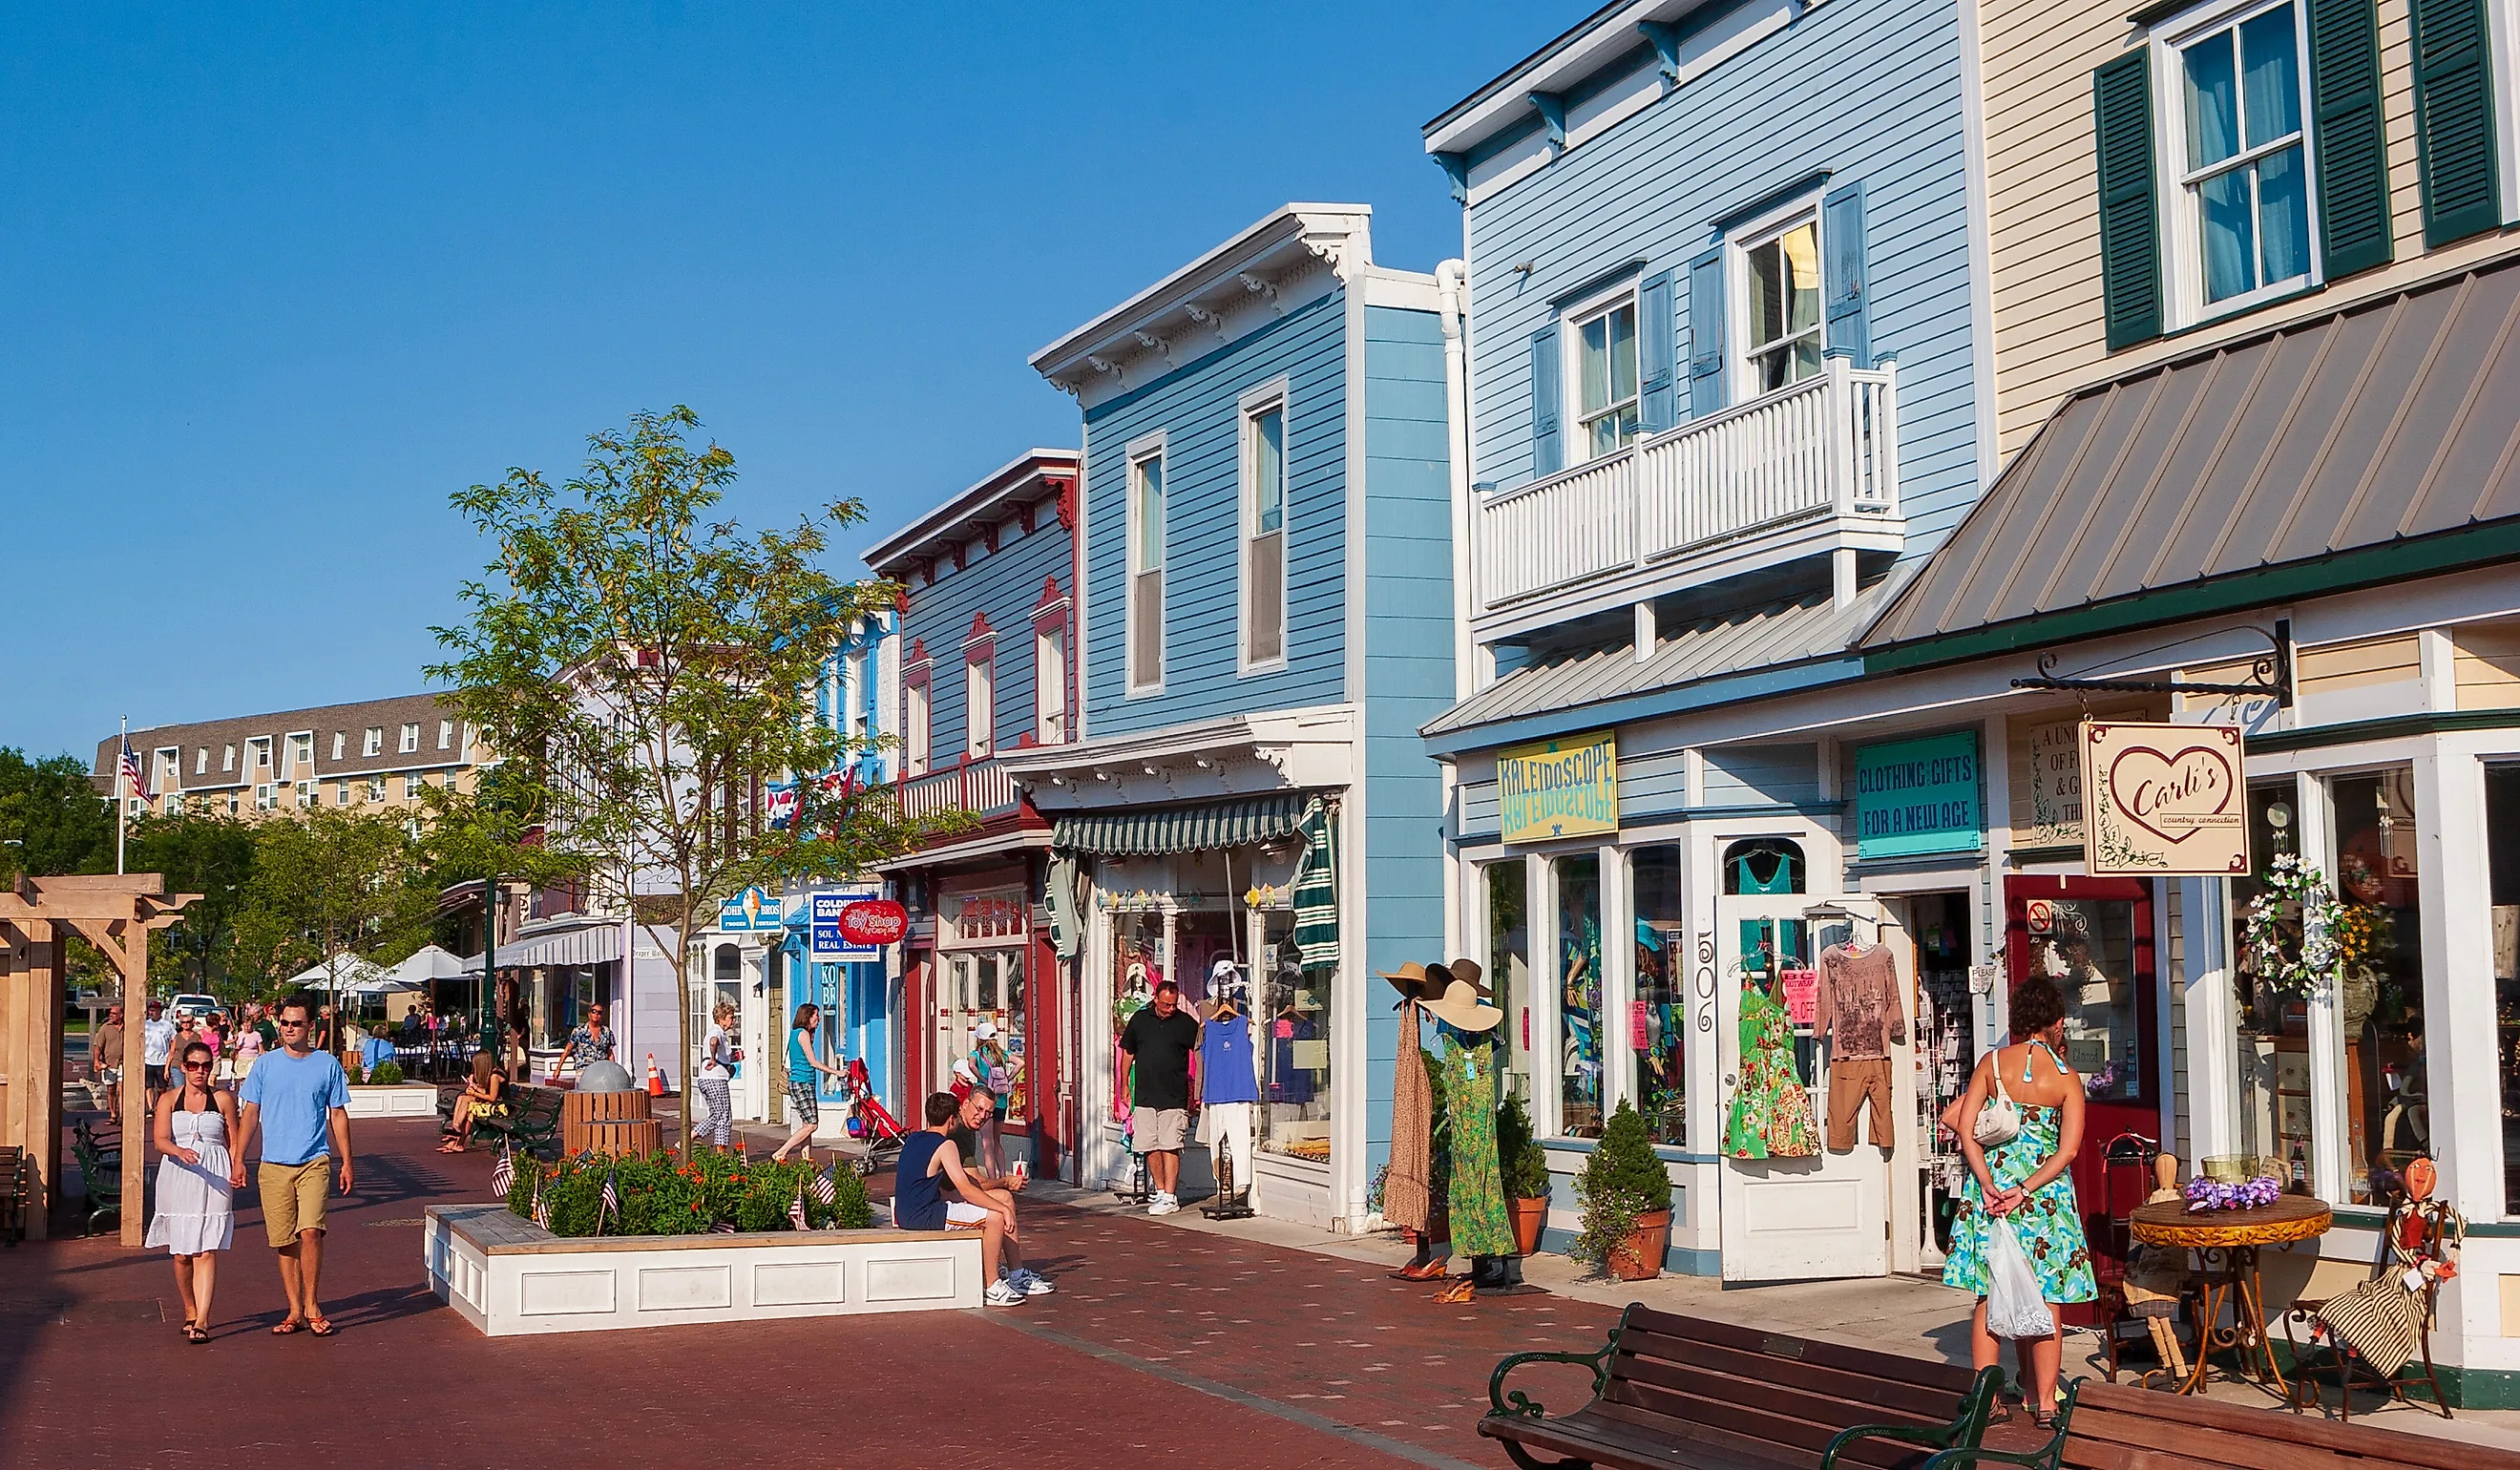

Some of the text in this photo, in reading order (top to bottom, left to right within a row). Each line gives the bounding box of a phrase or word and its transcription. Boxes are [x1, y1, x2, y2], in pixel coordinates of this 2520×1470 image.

[2043, 726, 2080, 747] A UNI
[1501, 739, 1613, 797] KALEIDOSCOPE
[2050, 752, 2066, 771] OF
[1858, 761, 1925, 794] CLOTHING
[1931, 755, 1972, 786] GIFTS
[2056, 777, 2067, 797] &
[2132, 756, 2219, 816] Carli's
[1863, 801, 1969, 835] FOR A NEW AGE
[2163, 816, 2195, 826] country
[760, 904, 780, 915] BROS
[846, 914, 901, 932] Toy Shop
[817, 930, 834, 938] SOL
[818, 940, 840, 950] REAL
[1695, 931, 1715, 1033] 506
[2072, 1047, 2099, 1063] Closed
